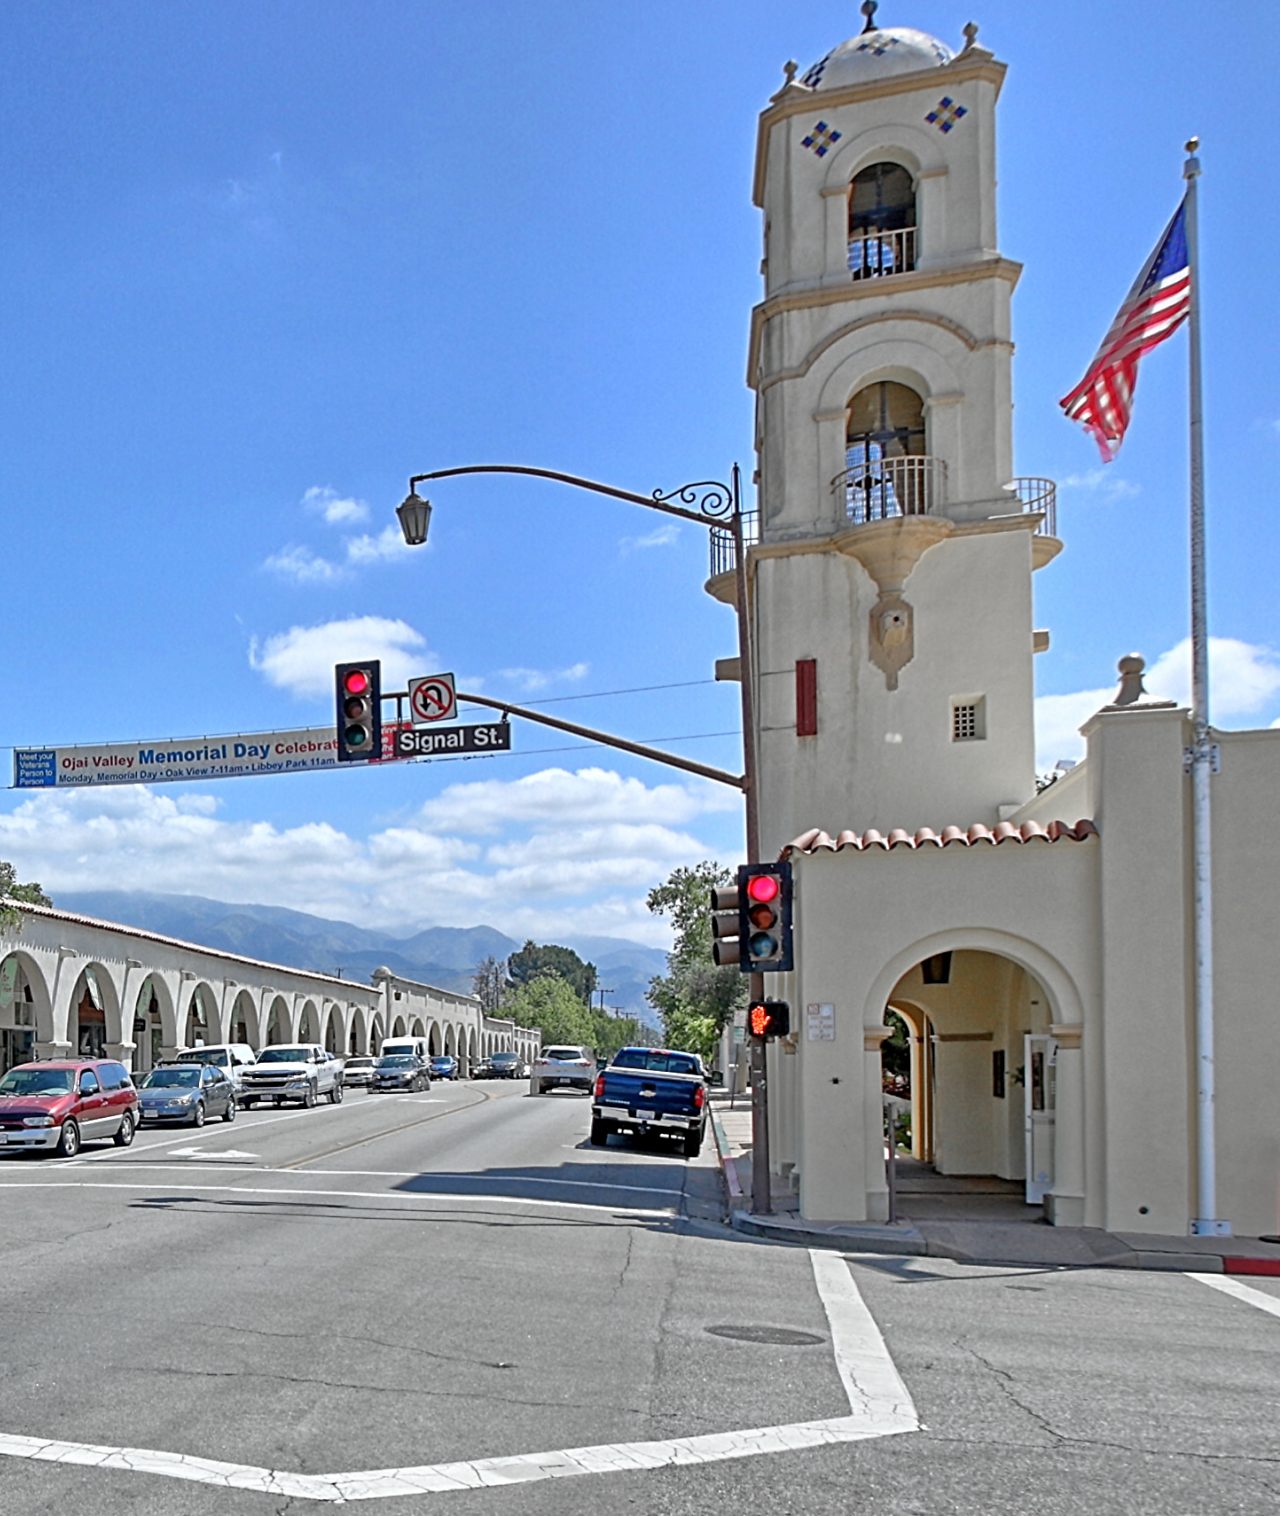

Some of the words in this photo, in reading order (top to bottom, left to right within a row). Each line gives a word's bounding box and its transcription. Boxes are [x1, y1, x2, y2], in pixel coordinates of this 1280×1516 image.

[400, 729, 464, 753] Signal
[473, 727, 503, 746] St.
[19, 753, 37, 761] Meet
[38, 752, 53, 761] your
[62, 757, 88, 770] Ojai
[93, 755, 135, 768] Valley
[138, 744, 227, 764] Memorial
[233, 743, 270, 759] Day
[275, 739, 339, 754] Celebrat
[19, 761, 50, 769] Veterans
[20, 769, 44, 777] Person
[59, 774, 95, 784] Monday,
[97, 771, 138, 781] Memorial
[140, 770, 157, 780] Day
[166, 768, 183, 777] Oak
[186, 766, 208, 775] View
[211, 764, 243, 773] 7-11am
[252, 761, 283, 771] Libbey
[286, 758, 307, 768] Park
[19, 777, 44, 785] Person
